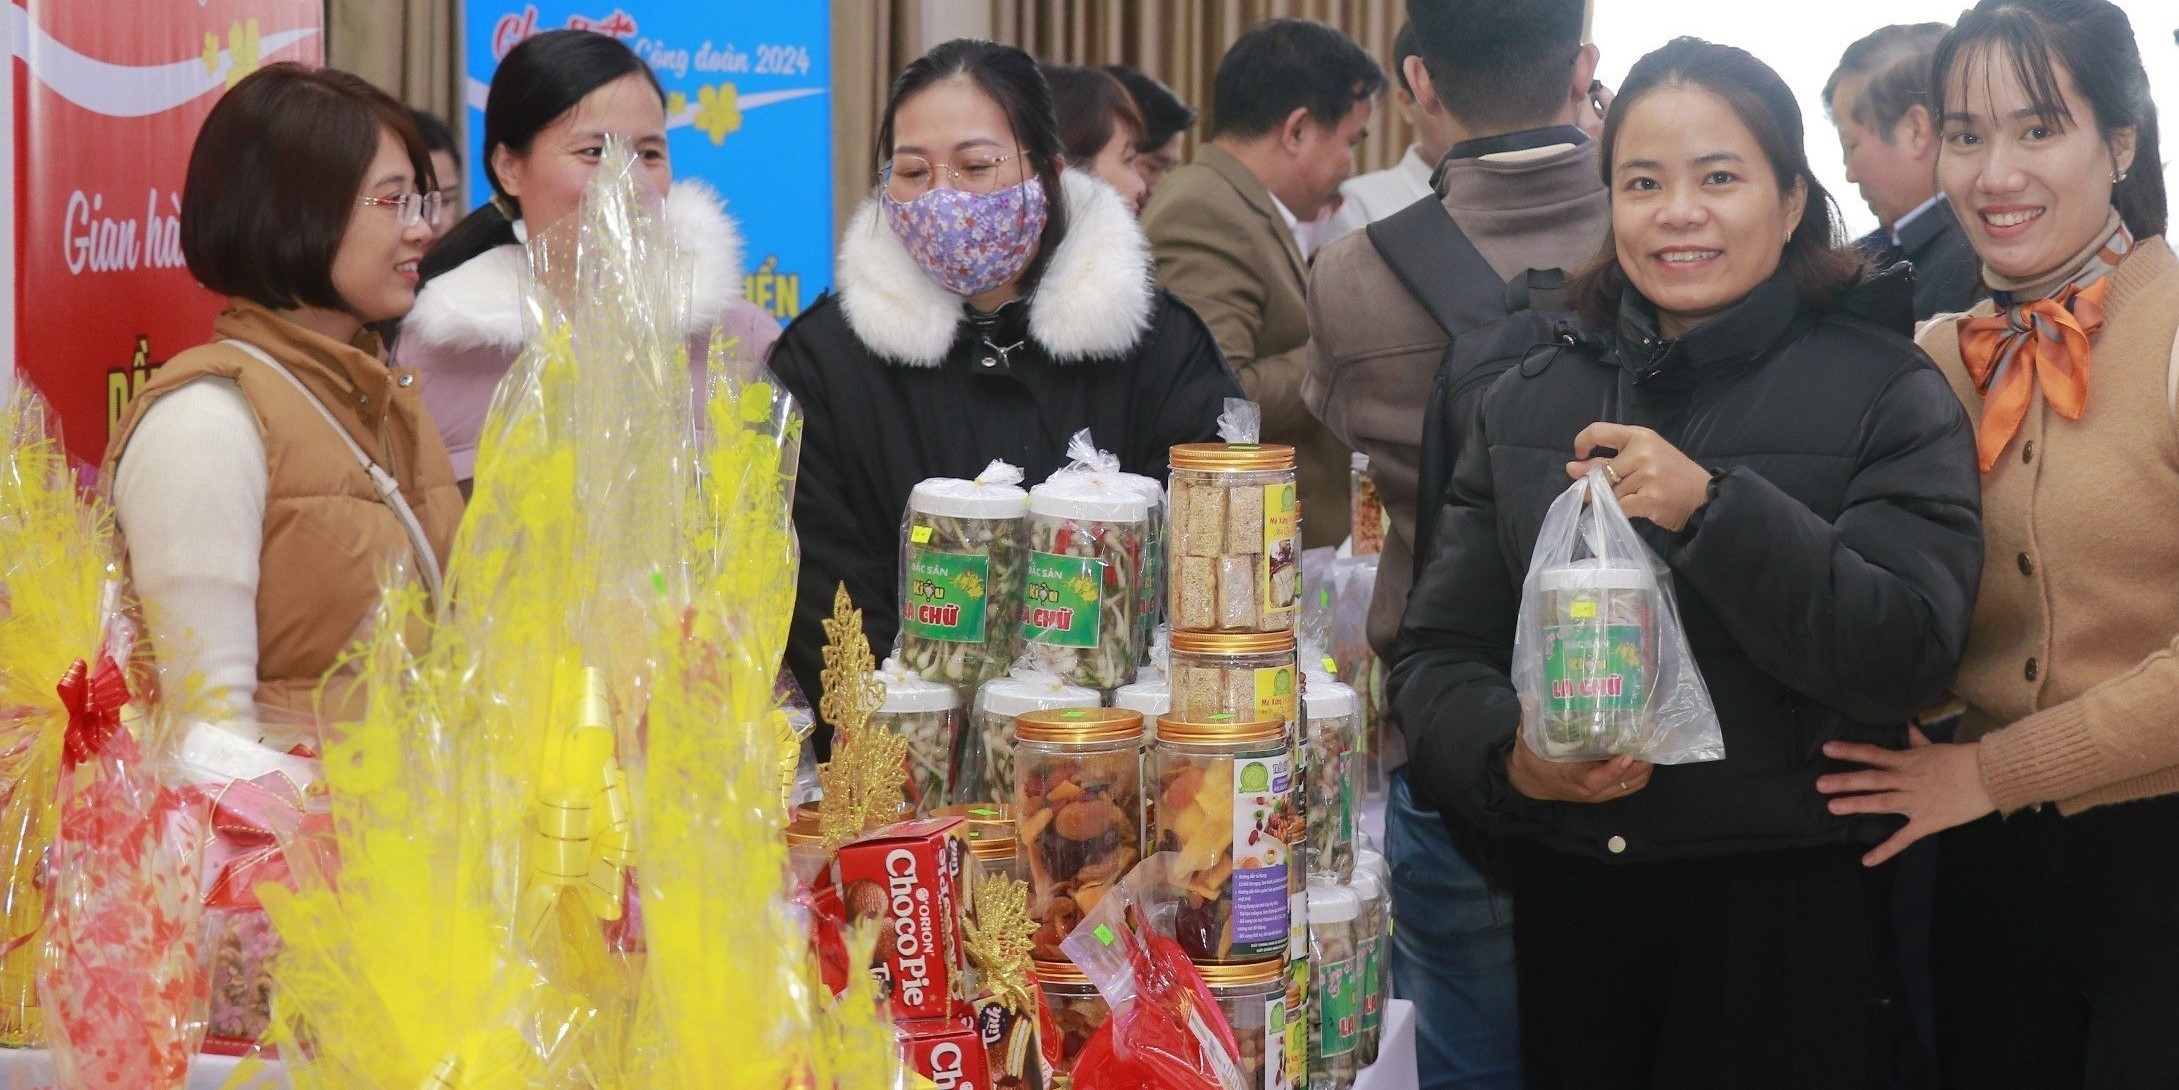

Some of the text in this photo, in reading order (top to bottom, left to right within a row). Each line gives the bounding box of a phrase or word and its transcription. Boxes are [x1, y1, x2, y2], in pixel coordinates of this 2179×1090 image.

[755, 44, 810, 75] 2024
[64, 189, 141, 275] Gian
[918, 603, 961, 627] CHỮ
[1033, 607, 1075, 632] CHỮ
[1553, 679, 1574, 698] LA
[885, 848, 918, 956] Choco
[918, 904, 935, 955] ORION
[898, 955, 930, 1007] Pie
[981, 1003, 1002, 1046] Tink
[1340, 1014, 1356, 1038] LA
